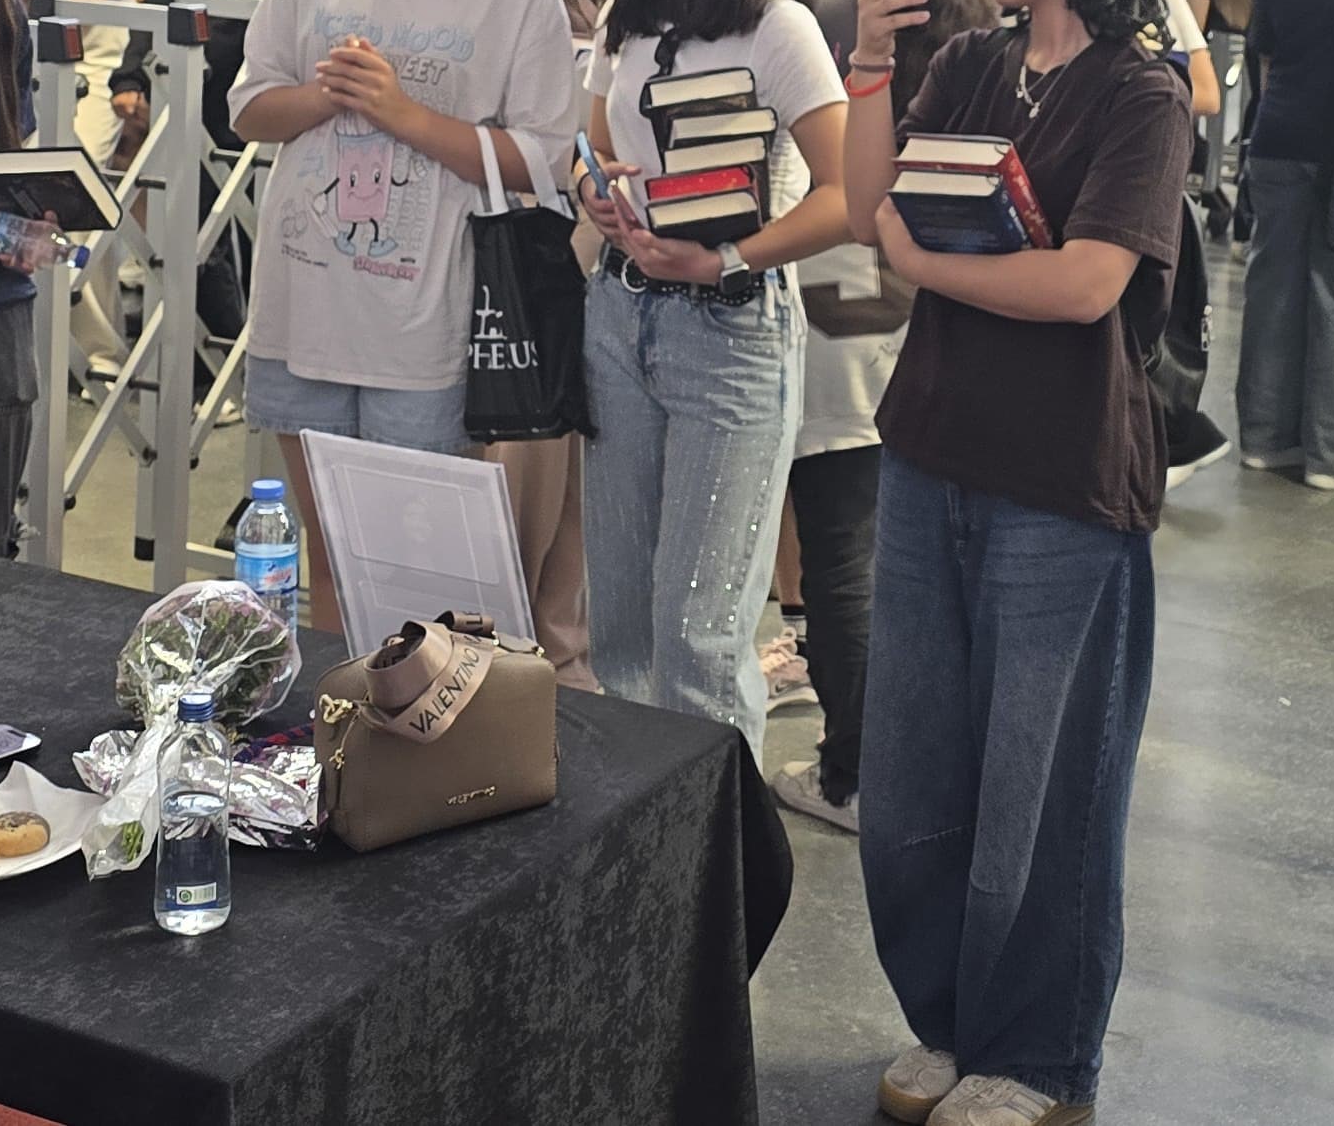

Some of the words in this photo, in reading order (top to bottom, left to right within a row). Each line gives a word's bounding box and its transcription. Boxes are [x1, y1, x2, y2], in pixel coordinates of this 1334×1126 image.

[389, 21, 476, 63] MOOD
[387, 52, 449, 86] WEET
[408, 647, 480, 735] VALENTINO
